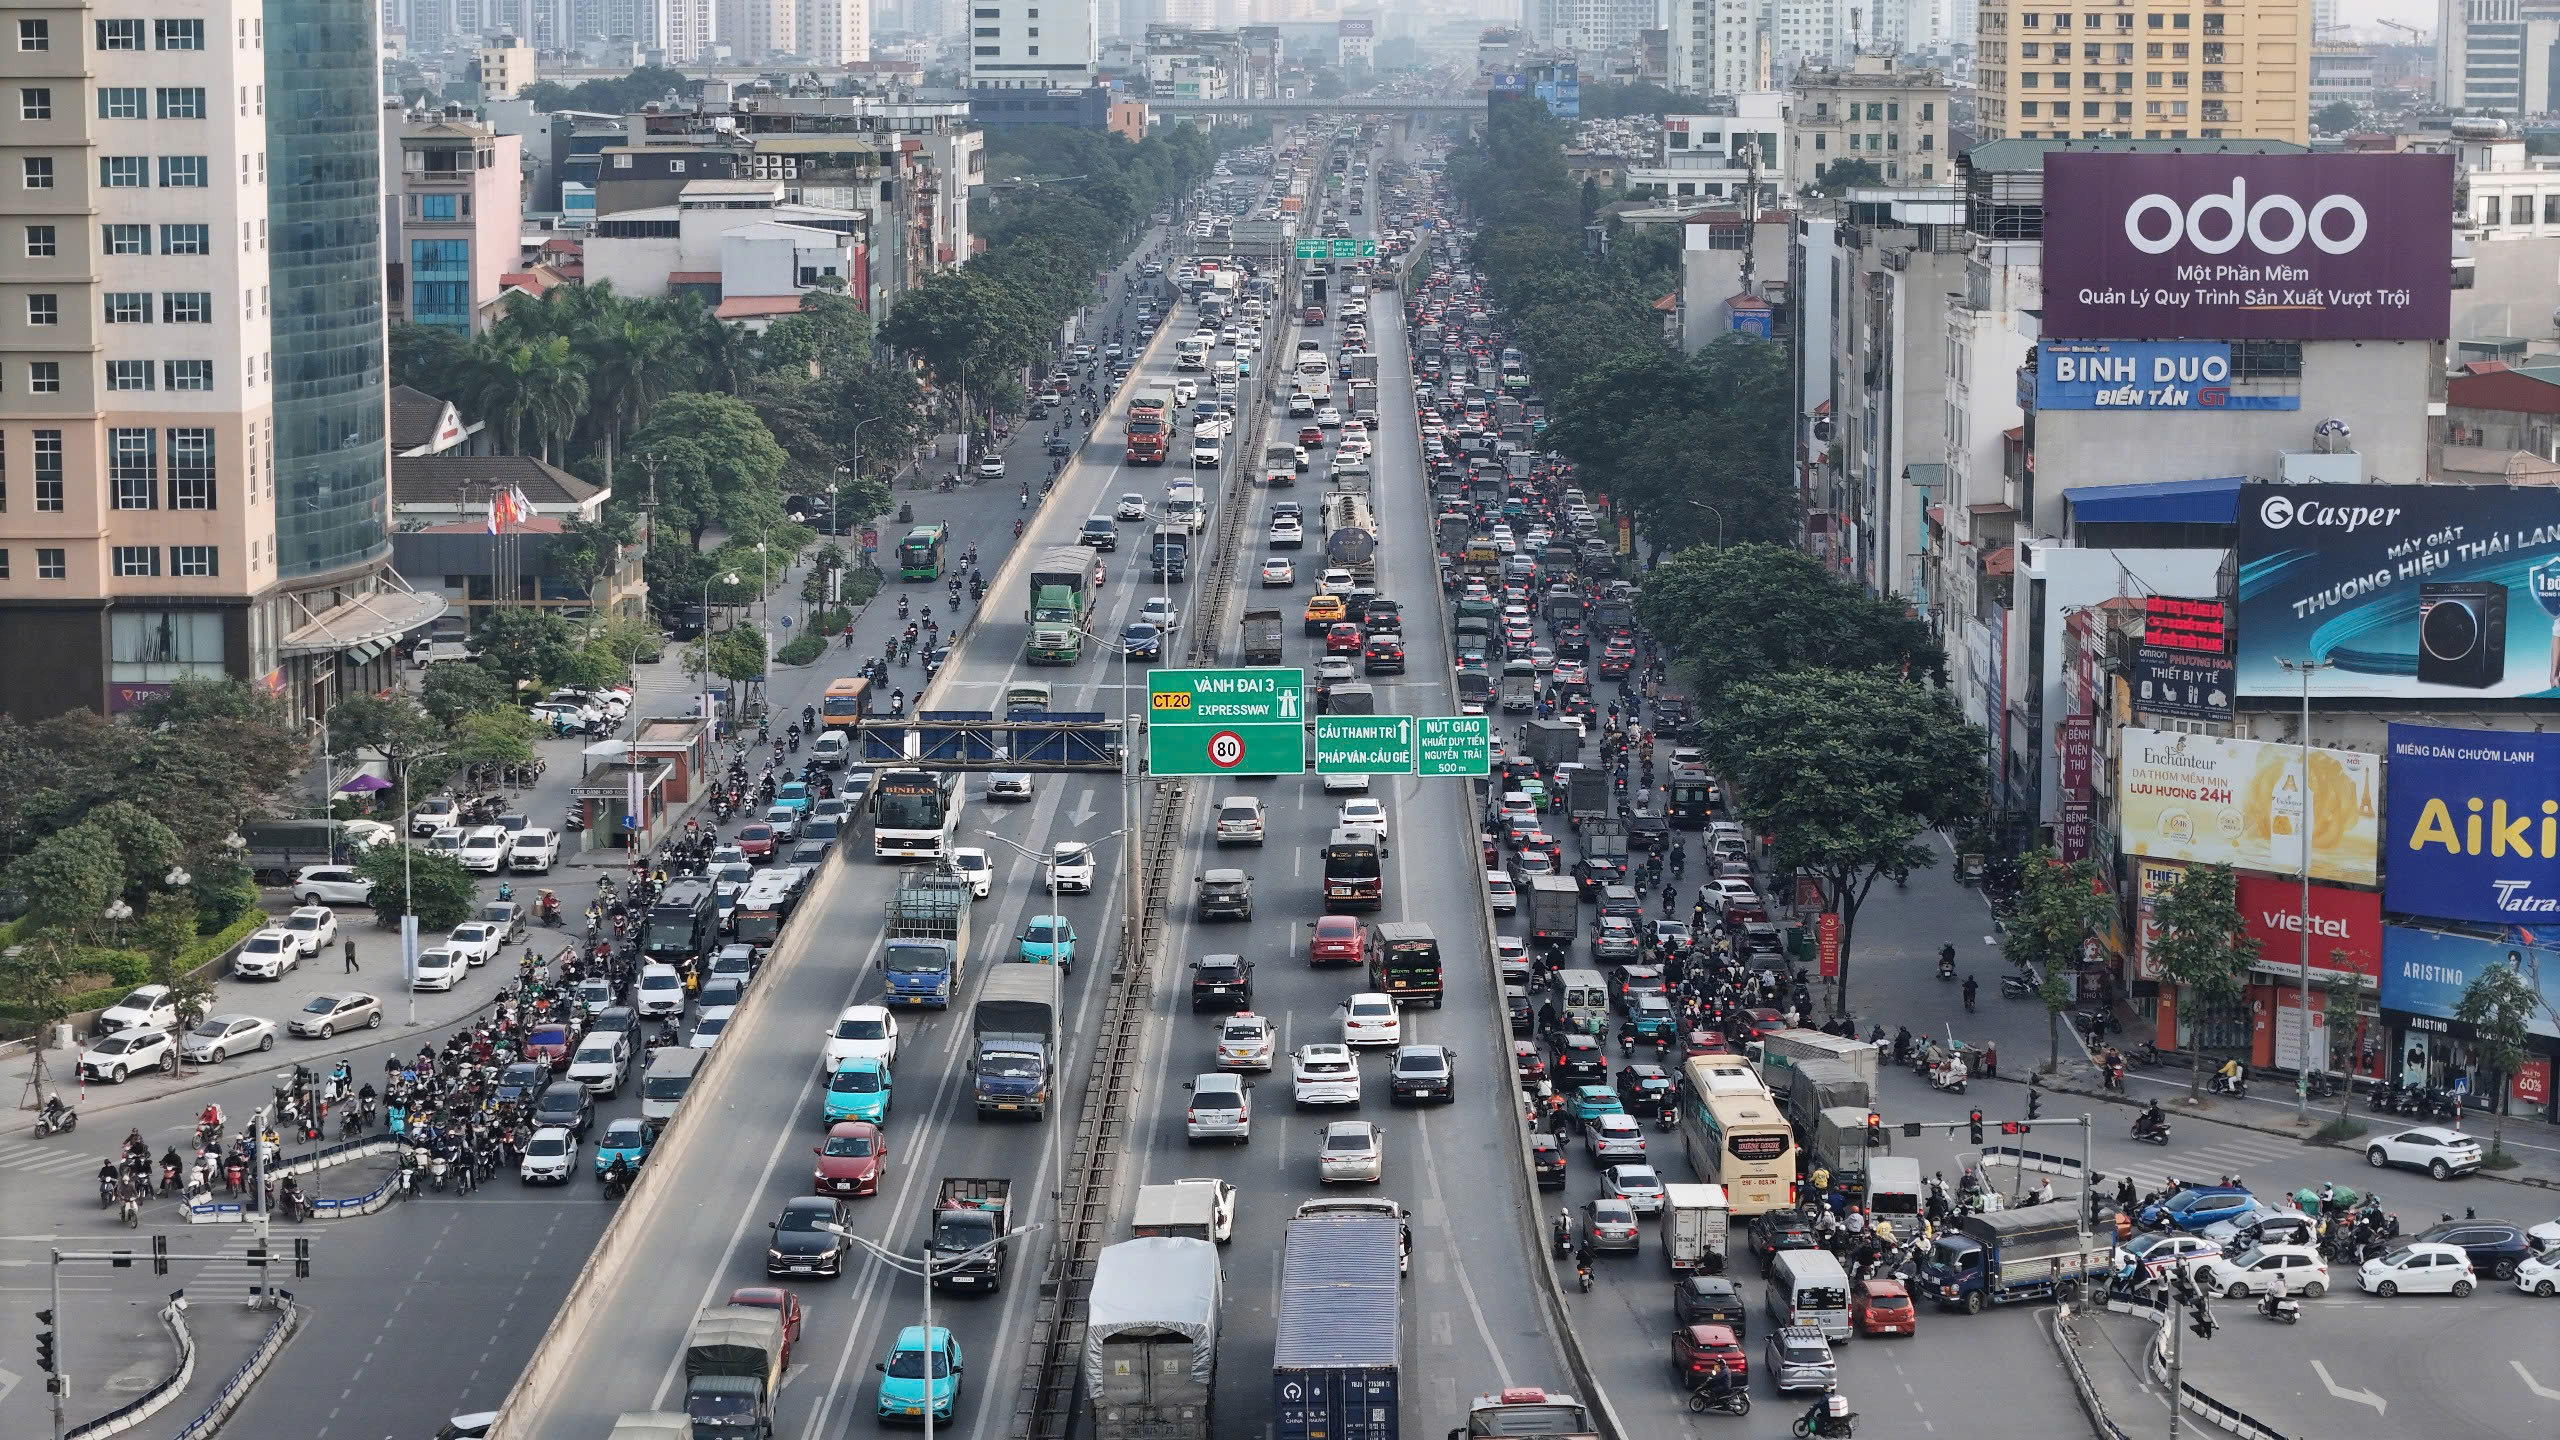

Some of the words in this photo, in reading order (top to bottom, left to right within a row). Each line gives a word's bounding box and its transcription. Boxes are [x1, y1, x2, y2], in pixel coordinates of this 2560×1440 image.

[2125, 176, 2368, 255] odoo
[2177, 265, 2211, 284] Một
[2216, 264, 2258, 282] Phần
[2265, 264, 2309, 281] Mềm
[2079, 288, 2125, 305] Quản
[2130, 290, 2150, 308] Lý
[2155, 290, 2190, 308] Quy
[2195, 289, 2240, 305] Trình
[2245, 288, 2278, 305] Sản
[2283, 288, 2324, 305] Xuất
[2329, 289, 2372, 309] Vượt
[2377, 288, 2411, 309] Trội
[2056, 357, 2136, 382] BINH
[2153, 356, 2228, 382] DUO
[2095, 384, 2144, 406] BIẾN
[2148, 384, 2189, 406] TẦN
[2297, 500, 2401, 532] Casper
[2387, 538, 2422, 560] MÁY
[2427, 525, 2464, 547] GIẶT
[2292, 569, 2392, 619] THƯƠNG
[2399, 550, 2450, 581] HIỆU
[2457, 531, 2510, 562] THÁI
[2139, 649, 2167, 659] OMRON
[2169, 654, 2211, 668] PHƯƠNG
[2212, 659, 2233, 670] HOA
[2151, 666, 2181, 680] THIẾT
[2183, 671, 2194, 683] BỊ
[2196, 672, 2204, 682] Y
[2206, 670, 2220, 684] TẾ
[1193, 676, 1234, 693] VÀNH
[1237, 679, 1262, 692] ĐAI
[1265, 678, 1275, 692] 3
[1153, 695, 1191, 708] CT.20
[1198, 704, 1270, 716] EXPRESSWAY
[1319, 723, 1341, 739] CẦU
[1342, 727, 1377, 739] THANH
[1380, 724, 1397, 739] TRÌ
[1426, 720, 1450, 733] NÚT
[1452, 721, 1480, 733] GIAO
[2069, 727, 2090, 741] BỆNH
[1421, 734, 1447, 747] KHUẤT
[1448, 737, 1465, 746] DUY
[1466, 733, 1485, 746] TIẾN
[1217, 742, 1236, 757] 80
[1424, 747, 1459, 760] NGUYỄN
[2070, 743, 2088, 756] VIỆN
[2396, 743, 2430, 757] MIẾNG
[2433, 746, 2455, 759] DÁN
[2458, 748, 2500, 762] CHƯỜM
[2504, 751, 2534, 764] LẠNH
[2071, 758, 2086, 771] THÚ
[2144, 746, 2216, 771] Enchanteur
[1438, 763, 1457, 773] 500
[2075, 775, 2081, 785] Y
[2132, 768, 2148, 778] DA
[2149, 769, 2178, 781] THƠM
[2180, 771, 2205, 785] MỀM
[2209, 776, 2229, 788] MỊN
[2130, 783, 2153, 796] LƯU
[2156, 785, 2197, 800] HƯƠNG
[2200, 787, 2232, 804] 24H
[2066, 811, 2087, 823] BỆNH
[2067, 825, 2086, 837] VIỆN
[2409, 797, 2559, 858] Aiki
[2069, 836, 2084, 848] THÚ
[2073, 850, 2079, 860] Y
[2403, 961, 2463, 986] ARISTINO
[2412, 1017, 2448, 1033] ARISTINO
[2520, 1078, 2541, 1091] 60%
